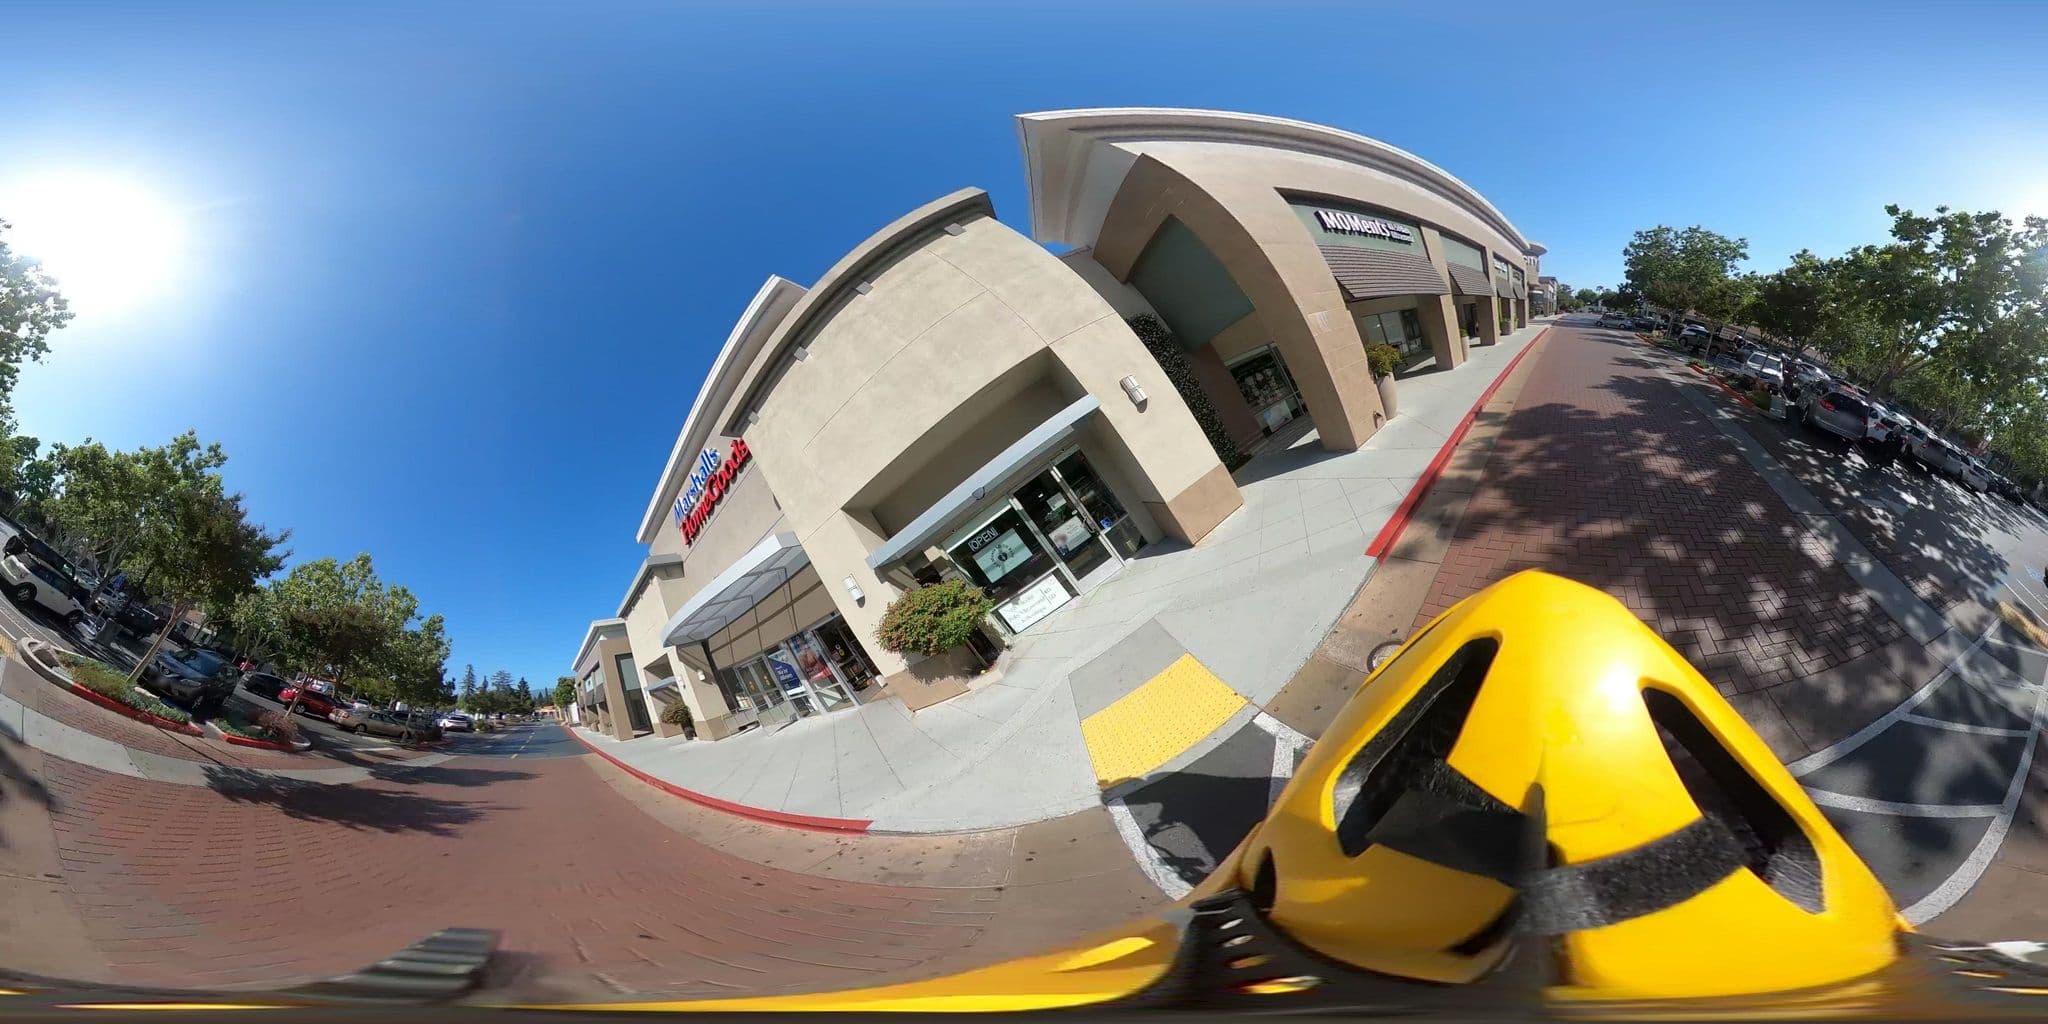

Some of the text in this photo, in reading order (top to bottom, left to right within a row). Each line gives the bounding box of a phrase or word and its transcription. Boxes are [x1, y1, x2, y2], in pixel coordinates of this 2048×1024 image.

[1317, 209, 1392, 238] MOMents
[674, 447, 720, 529] Marshalls
[679, 437, 751, 546] HomeGoods
[971, 527, 998, 551] OPEN
